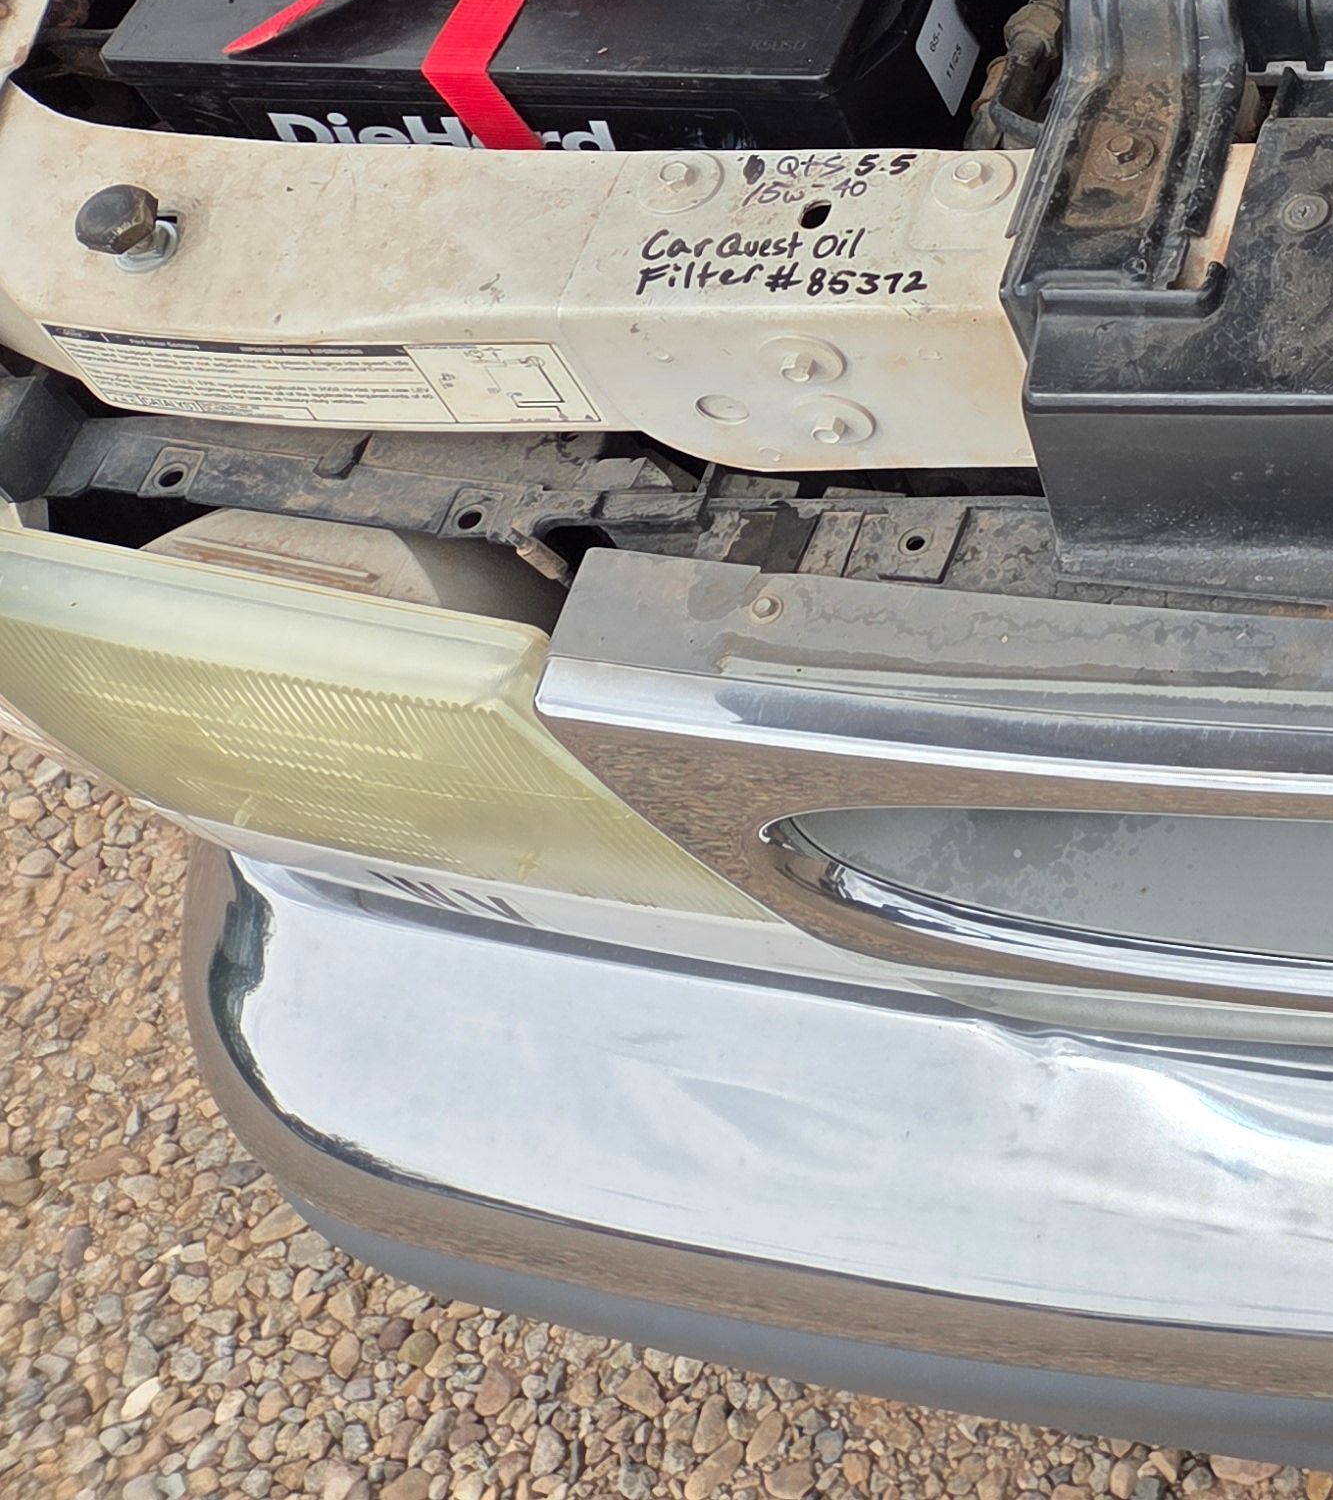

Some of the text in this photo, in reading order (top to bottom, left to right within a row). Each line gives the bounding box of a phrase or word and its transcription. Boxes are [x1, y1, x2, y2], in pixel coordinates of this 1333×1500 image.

[267, 111, 617, 151] DieHrd
[812, 227, 866, 260] Oil
[635, 260, 764, 296] Filter
